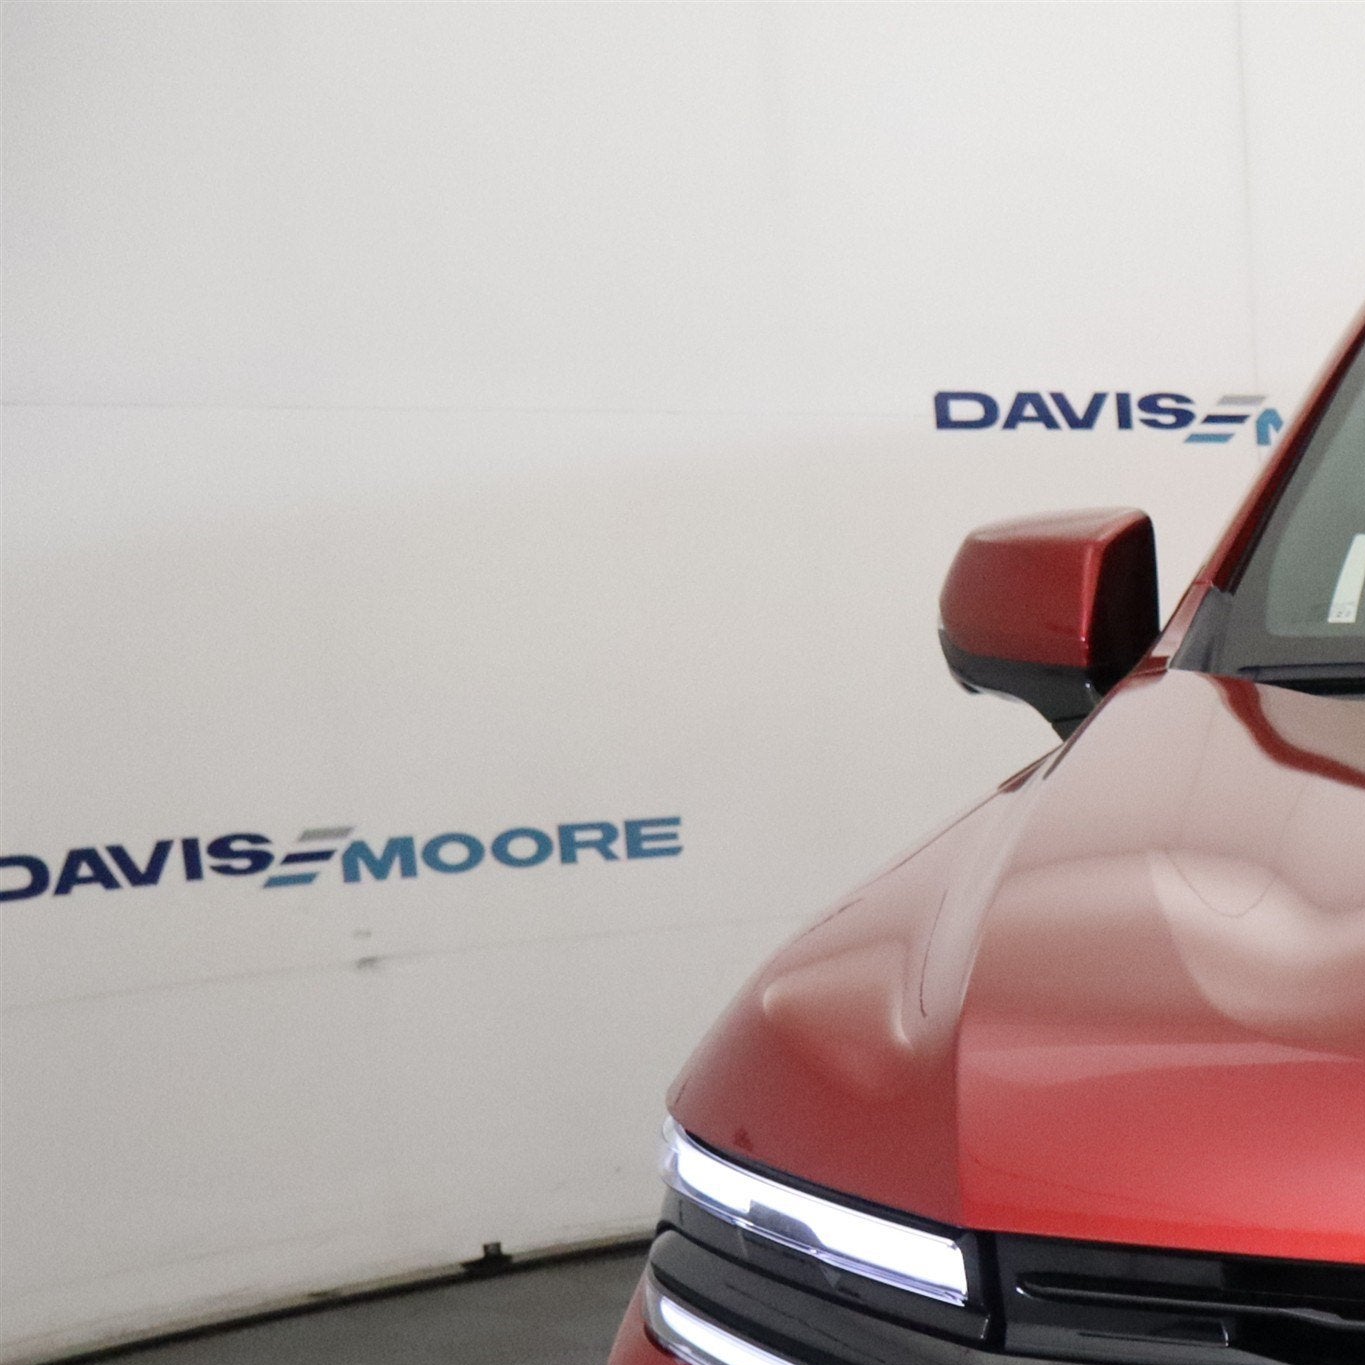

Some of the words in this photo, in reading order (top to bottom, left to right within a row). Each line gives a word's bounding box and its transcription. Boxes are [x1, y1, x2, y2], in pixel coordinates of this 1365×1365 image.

[934, 391, 1197, 431] DAVIS
[0, 833, 273, 902] DAVIS
[342, 816, 684, 885] MOORE
